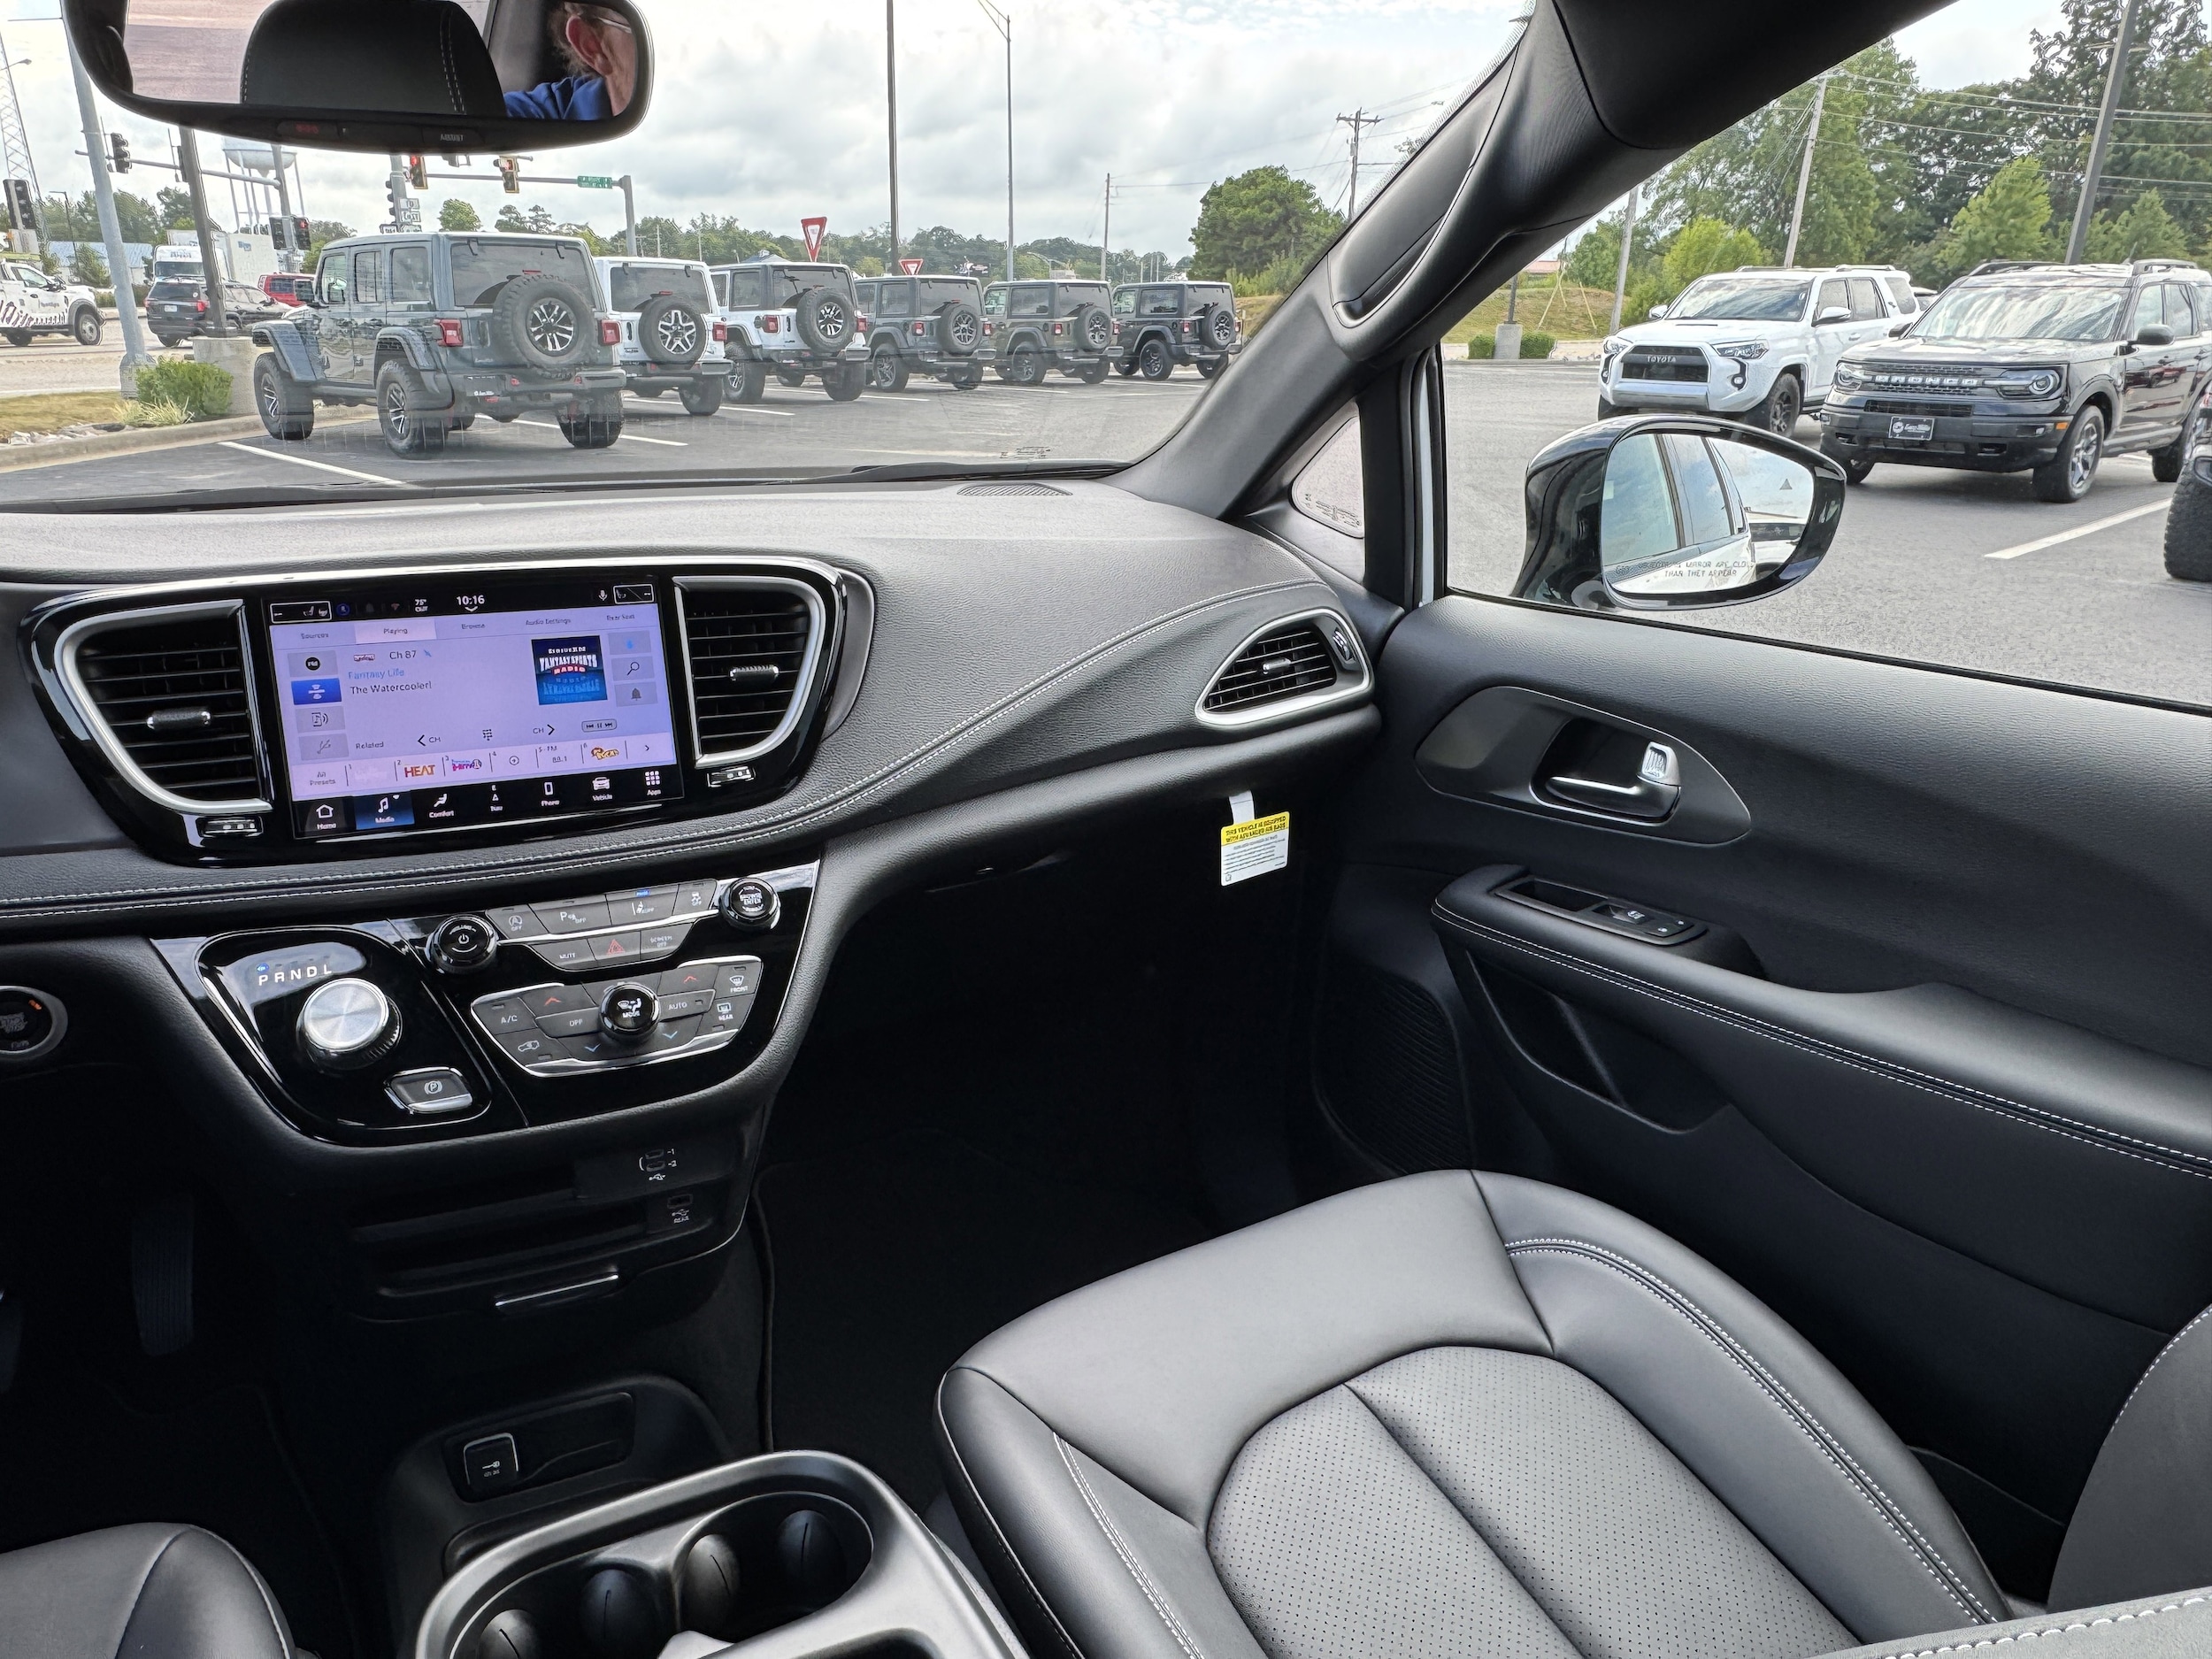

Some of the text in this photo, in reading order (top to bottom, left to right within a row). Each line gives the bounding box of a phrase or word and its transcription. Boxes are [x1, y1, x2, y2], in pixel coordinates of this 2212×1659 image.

[1875, 375, 1978, 388] BRONCO
[456, 594, 486, 605] 10:16
[389, 650, 417, 660] Ch 87
[348, 668, 404, 681] Fantasy Life
[350, 686, 368, 695] The
[428, 735, 442, 744] CH
[356, 741, 385, 750] Related
[404, 764, 436, 779] HEAT
[501, 1014, 518, 1024] A/C
[569, 1018, 583, 1027] OFF
